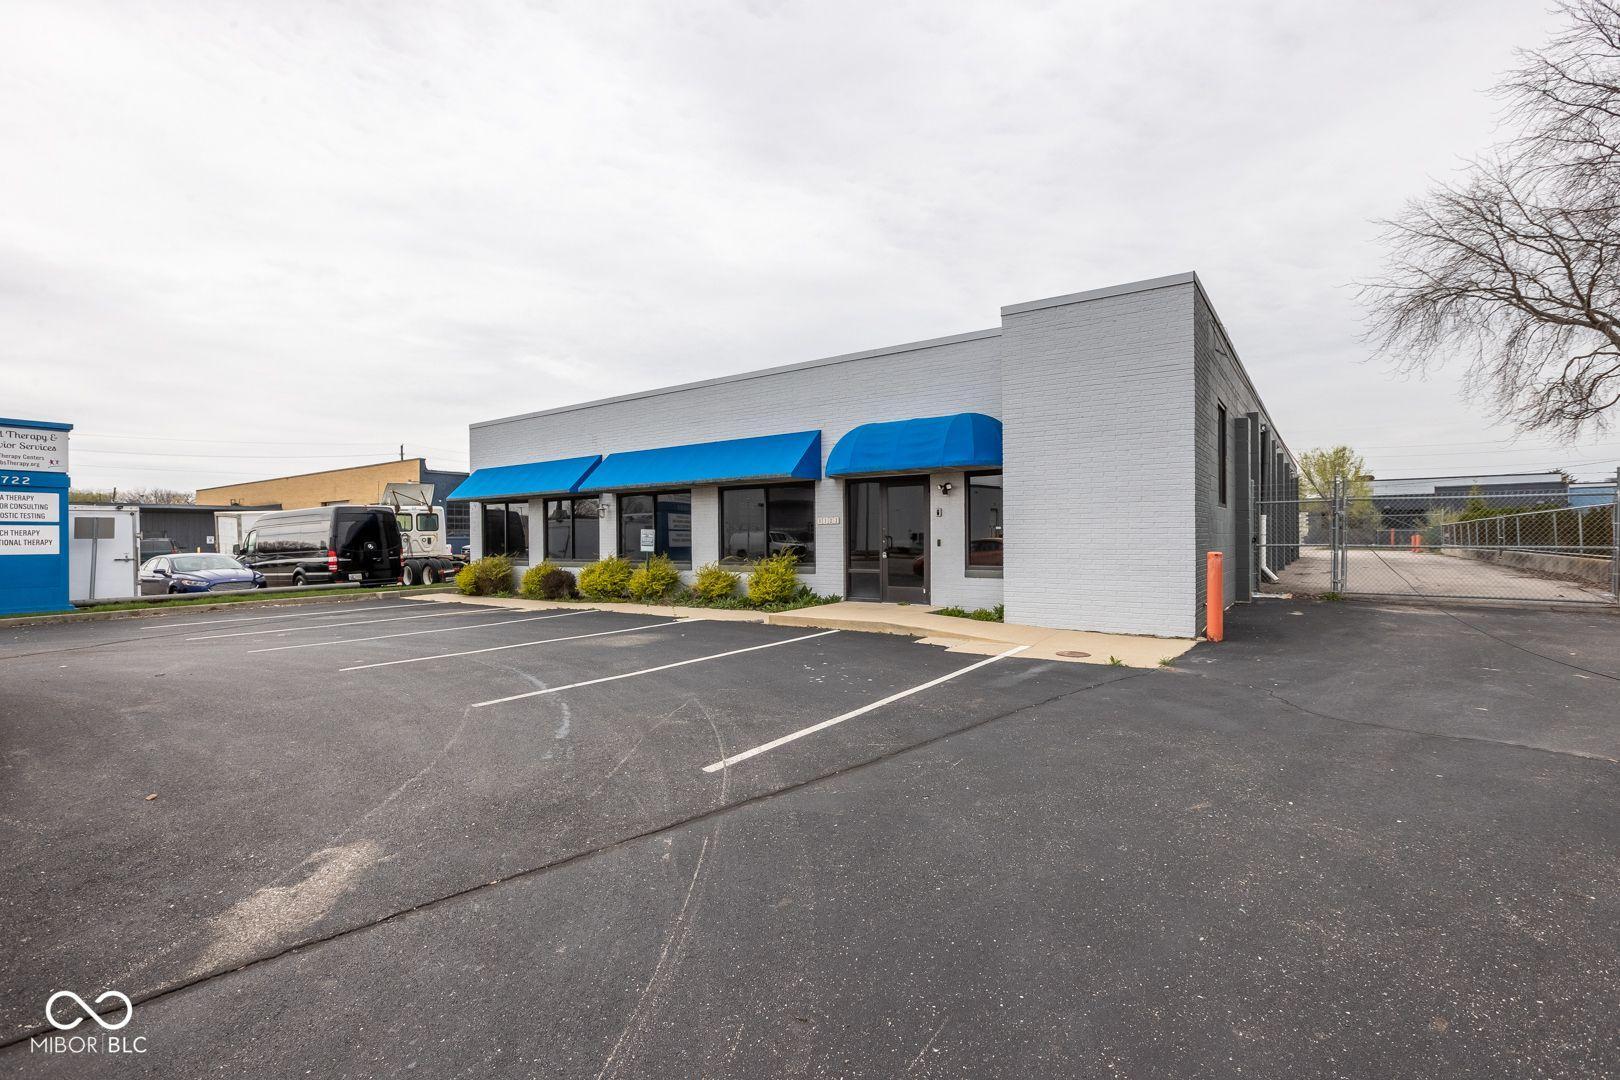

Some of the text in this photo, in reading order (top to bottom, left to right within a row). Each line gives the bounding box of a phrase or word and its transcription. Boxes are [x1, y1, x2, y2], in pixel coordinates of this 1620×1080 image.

[6, 430, 47, 442] Therapy
[19, 441, 57, 451] Services
[1, 475, 30, 485] 722
